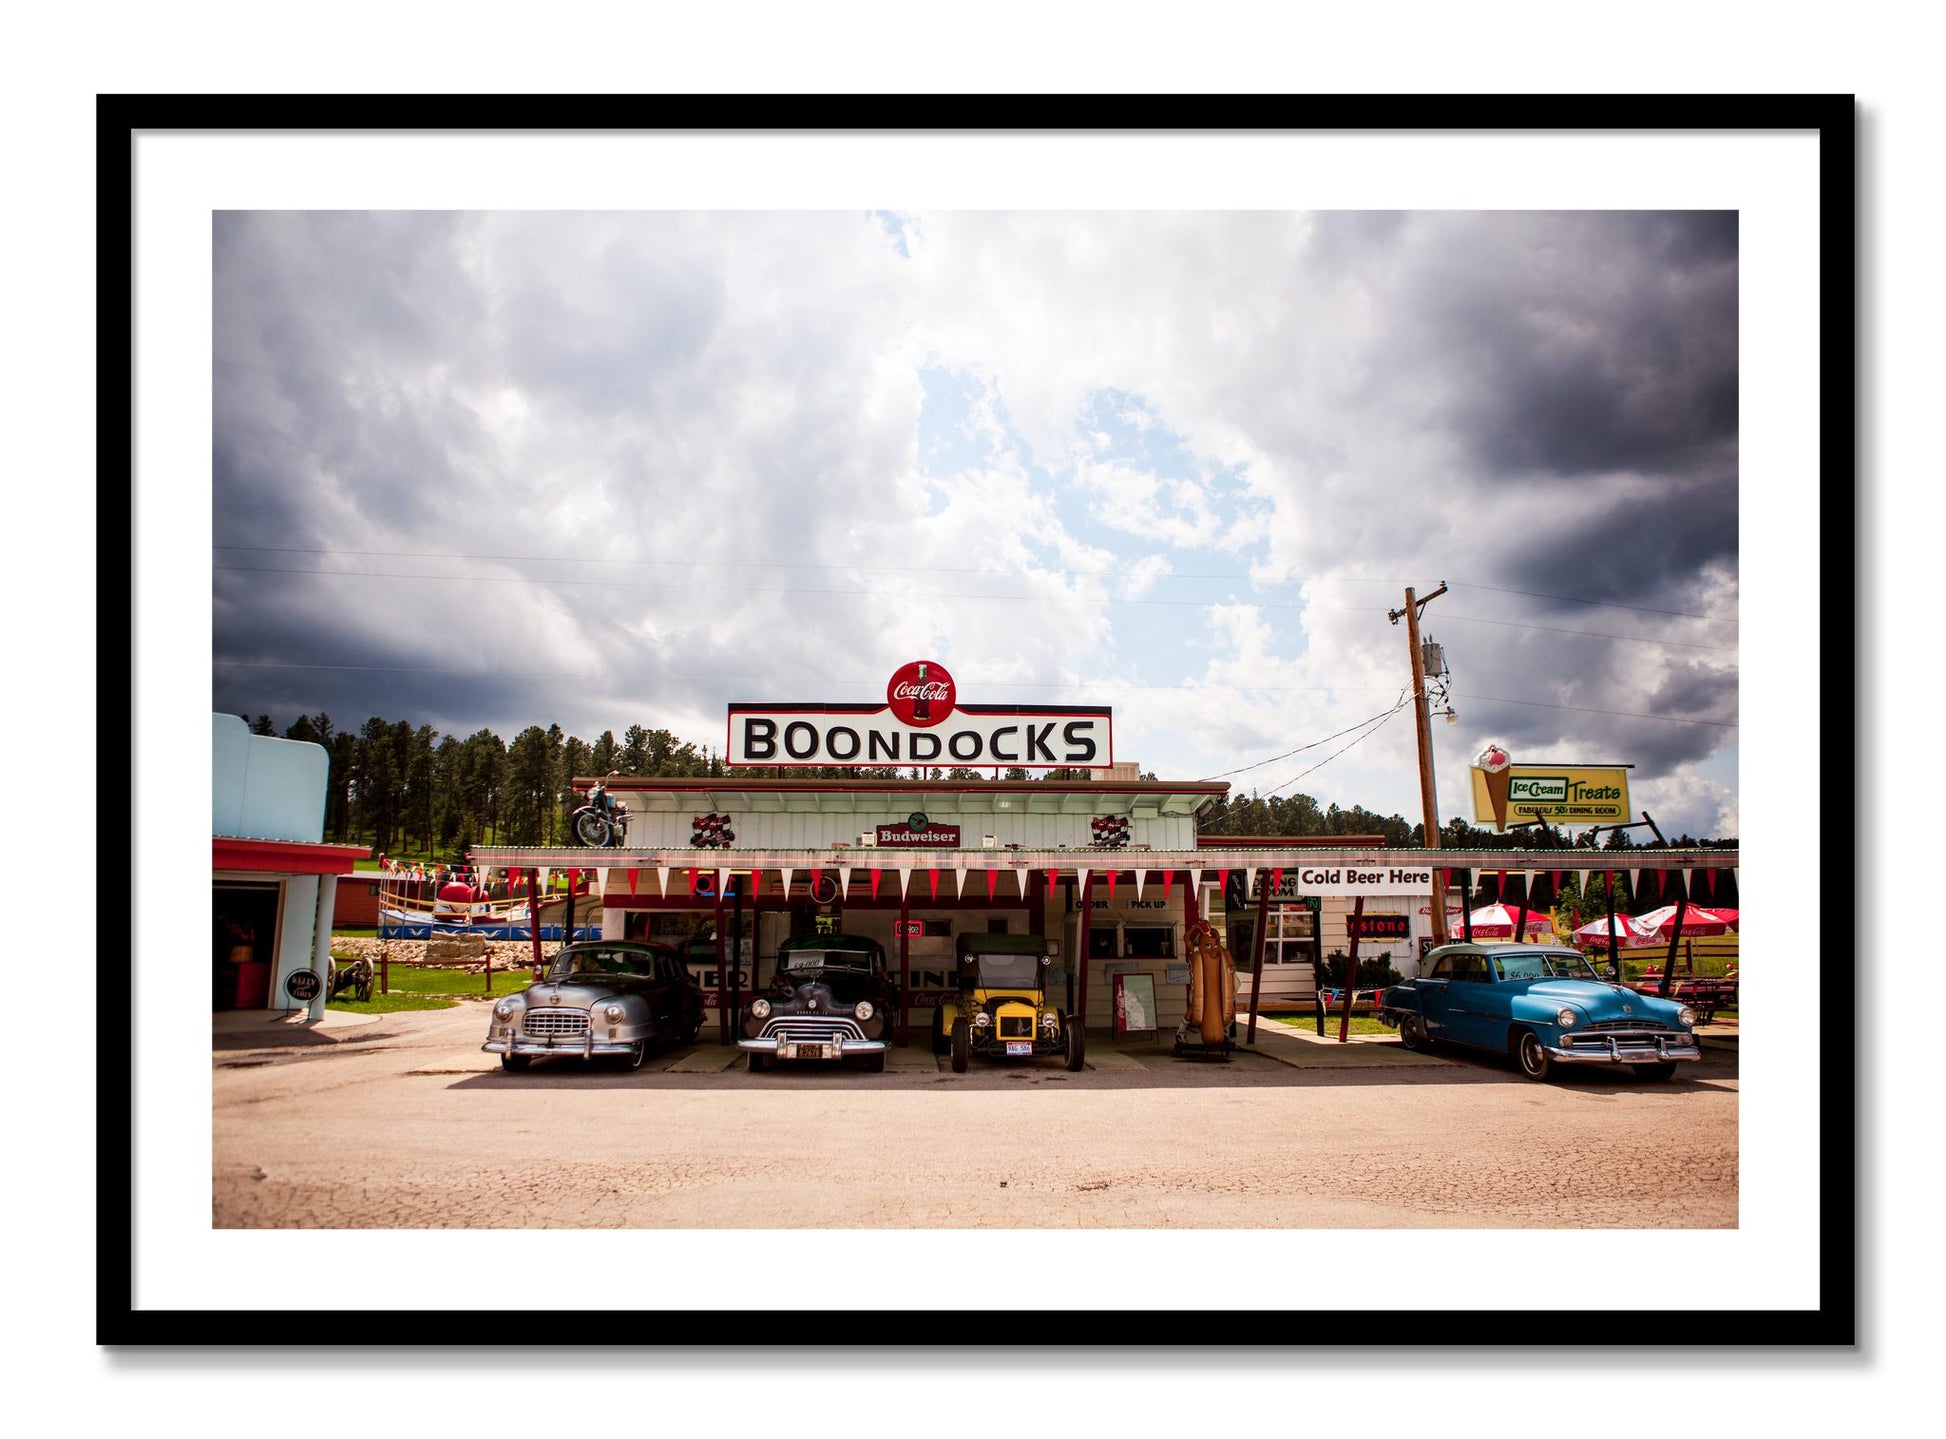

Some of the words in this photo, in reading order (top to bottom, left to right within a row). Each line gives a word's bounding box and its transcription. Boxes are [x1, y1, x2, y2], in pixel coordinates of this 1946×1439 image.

[893, 680, 950, 701] Coca-Cola
[743, 717, 1097, 761] BOONDOCKS
[1513, 782, 1528, 794] Ice
[1529, 782, 1563, 797] Cream
[1569, 781, 1620, 802] Treats
[880, 831, 956, 842] Budweiser
[1302, 869, 1340, 884] Cold
[1346, 869, 1384, 884] Beer
[1389, 869, 1430, 883] Here
[1253, 887, 1294, 896] ROM
[1076, 900, 1108, 908] ODER
[1131, 900, 1151, 908] PICK
[1154, 900, 1166, 908] UP
